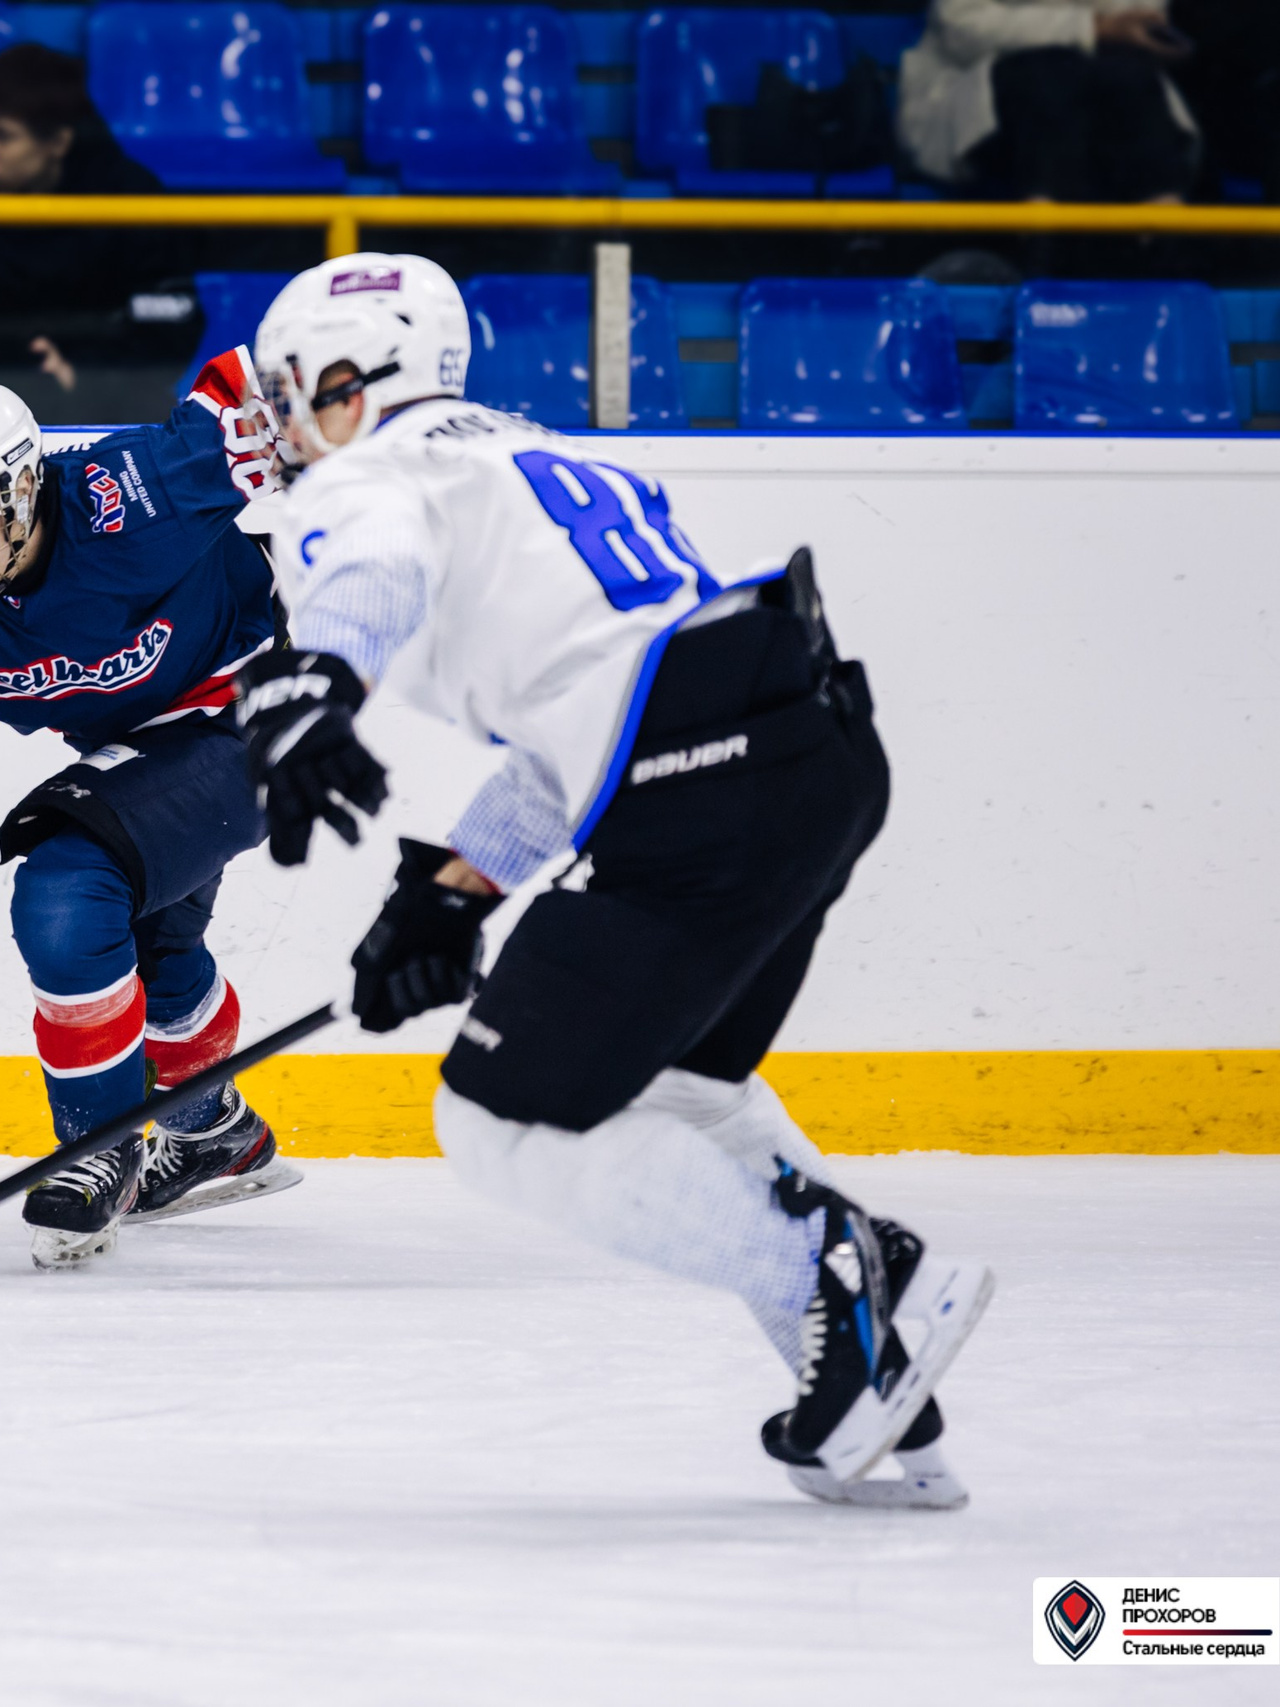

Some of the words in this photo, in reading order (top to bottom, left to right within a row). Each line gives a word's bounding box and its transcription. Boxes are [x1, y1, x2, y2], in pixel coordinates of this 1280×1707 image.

[121, 450, 143, 486] COMPANY
[119, 470, 138, 502] MINING
[136, 485, 157, 518] UNITED
[631, 734, 749, 785] BAUER
